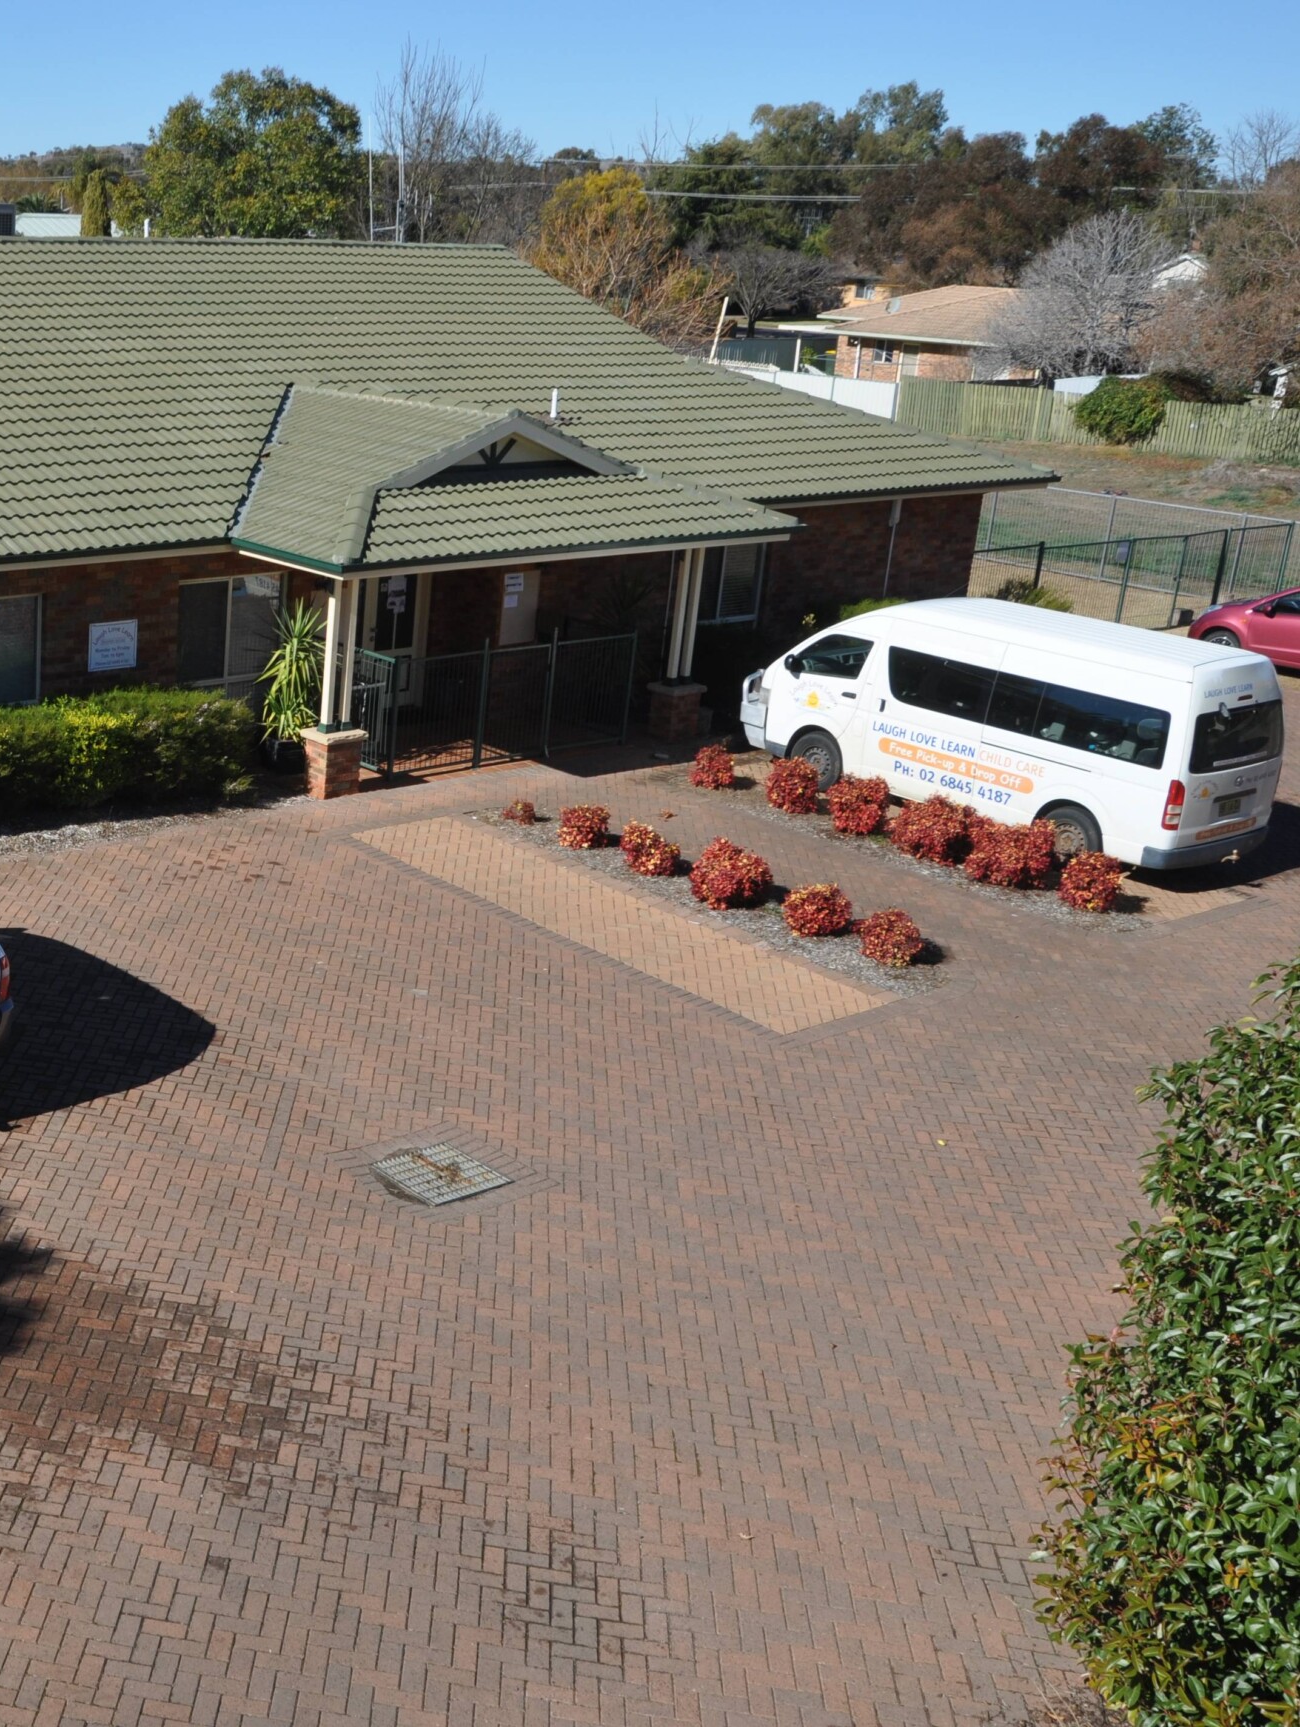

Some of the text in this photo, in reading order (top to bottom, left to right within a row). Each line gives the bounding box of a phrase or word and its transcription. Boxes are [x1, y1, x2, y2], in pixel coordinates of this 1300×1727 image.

[873, 720, 1046, 778] LAUGH LOVE LEARN CHILD CARE
[889, 739, 1022, 789] Free Pick-up & Drop Off
[919, 768, 935, 784] 02
[940, 775, 972, 794] 6845
[977, 786, 1012, 806] 4187
